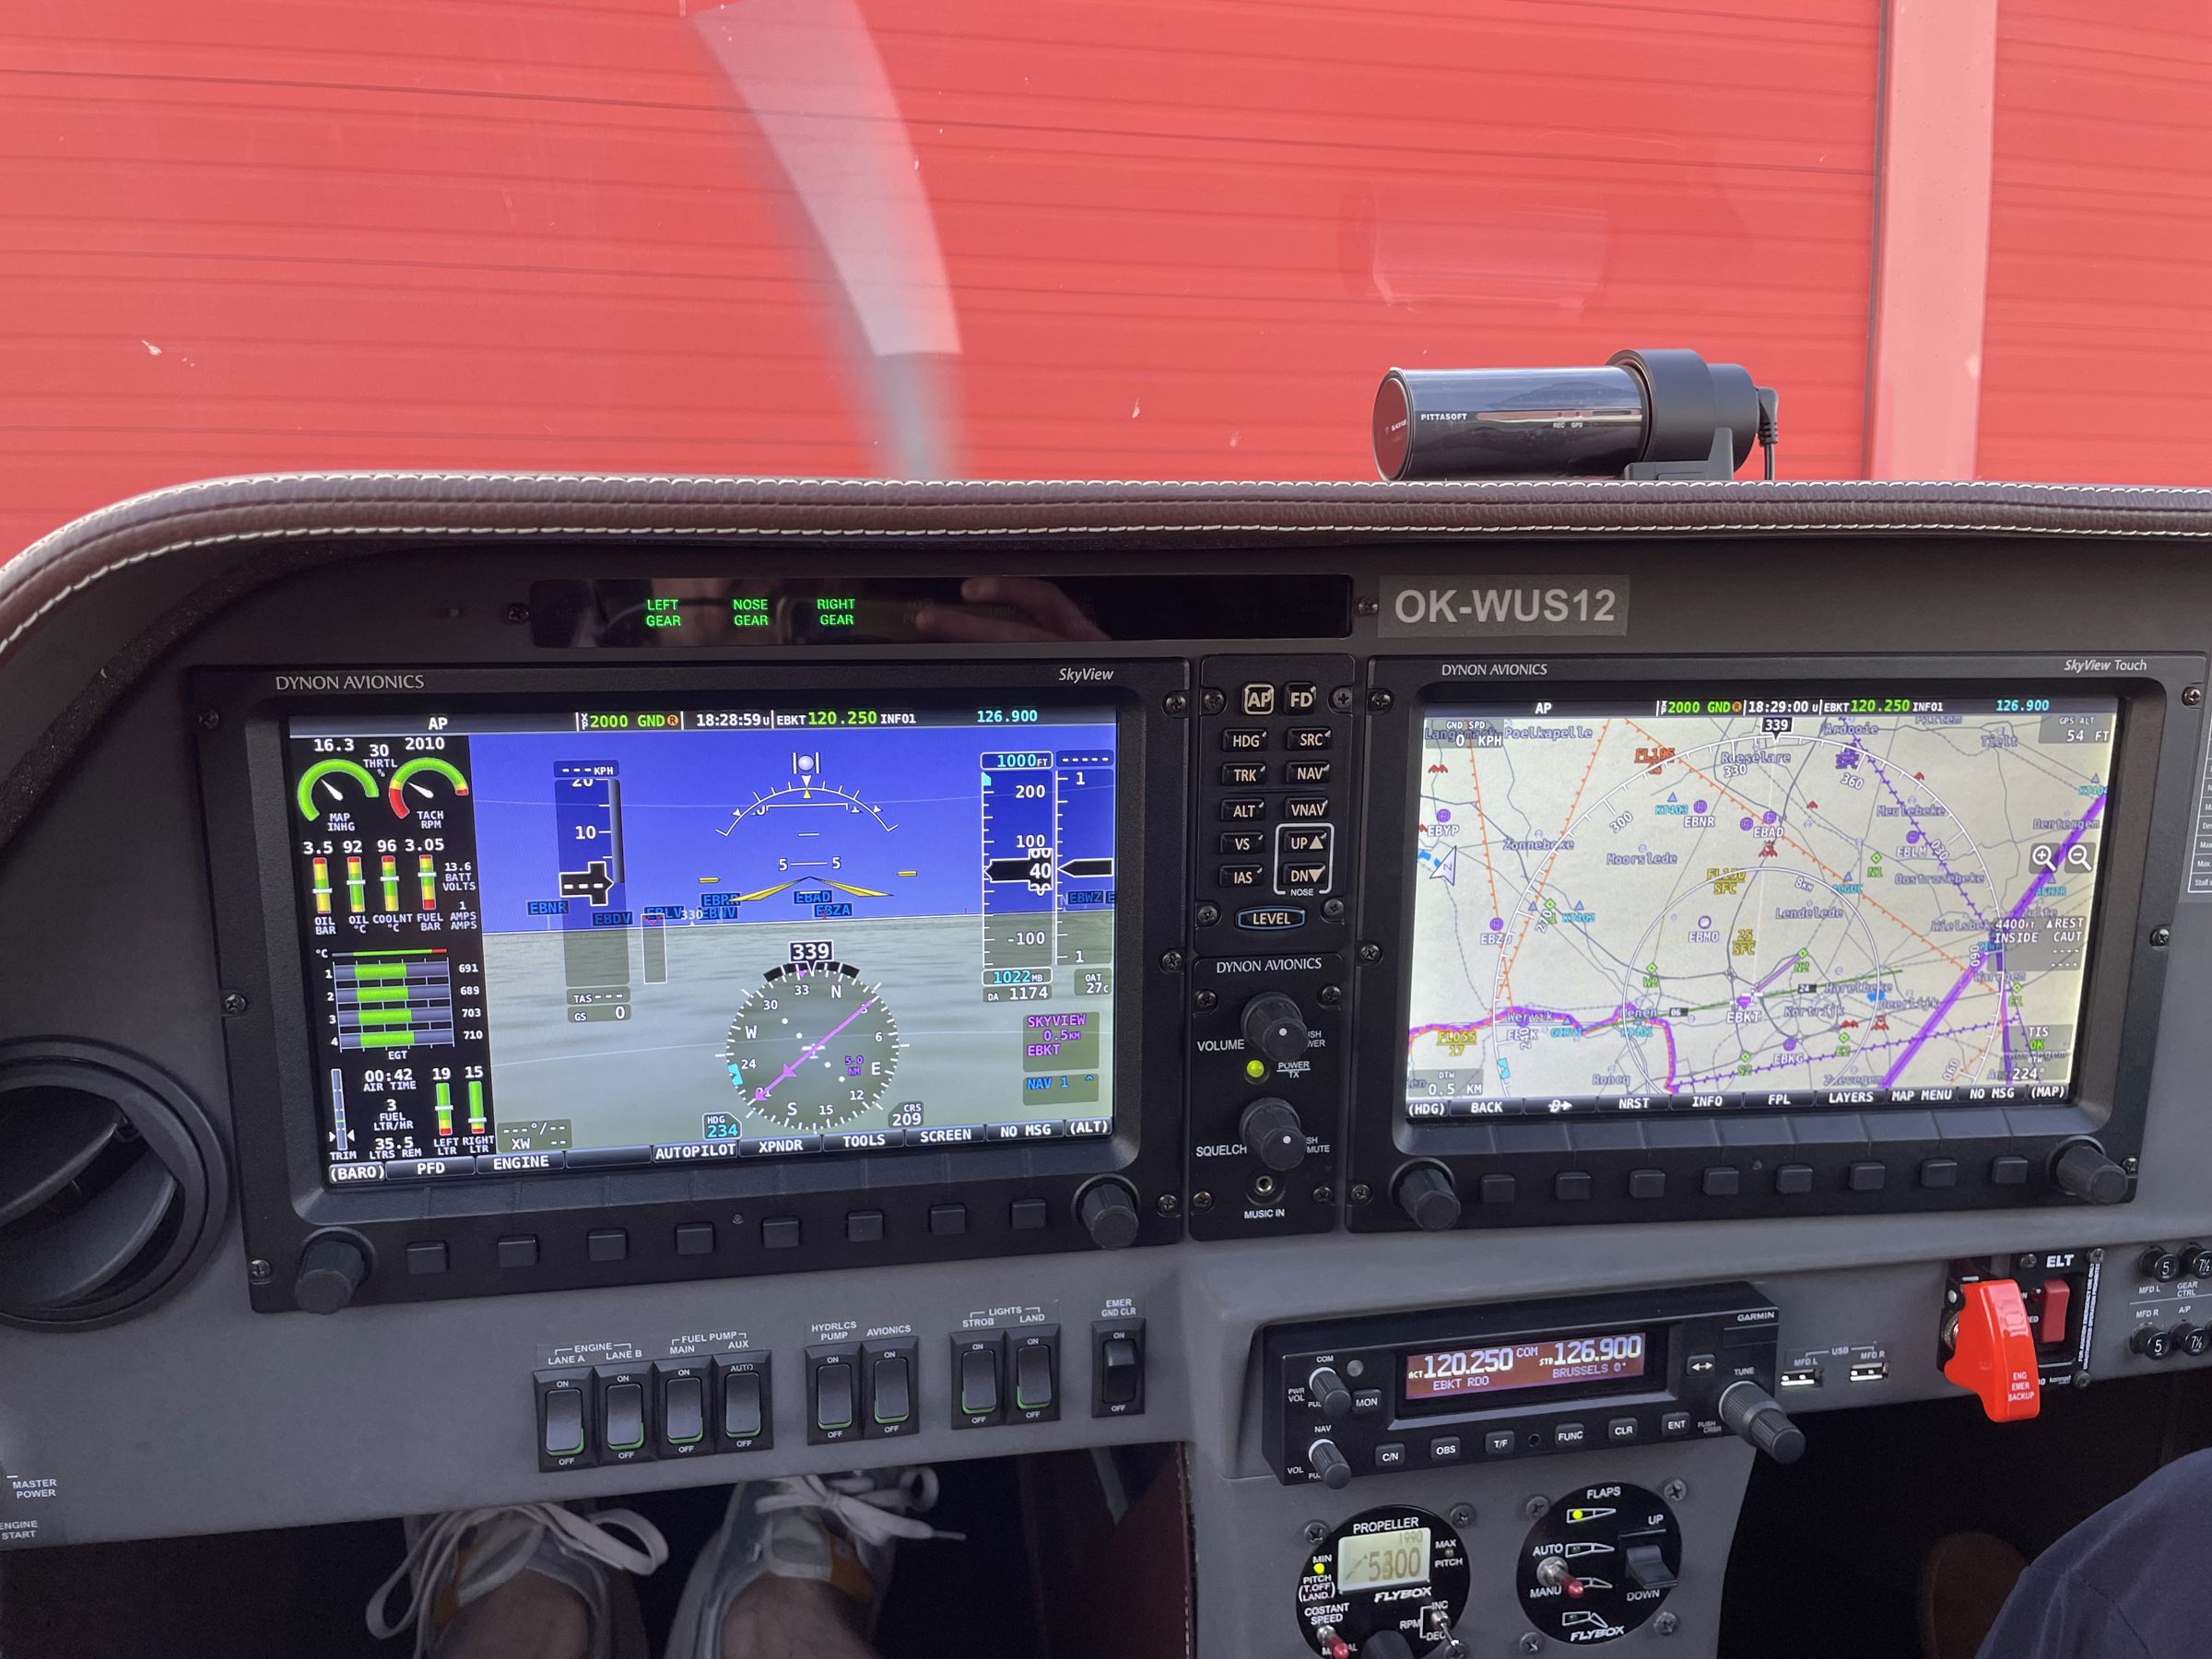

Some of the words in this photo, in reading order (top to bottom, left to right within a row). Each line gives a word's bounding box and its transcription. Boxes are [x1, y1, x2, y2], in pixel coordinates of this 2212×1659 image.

[1420, 413, 1467, 421] PITTASOFT
[647, 599, 678, 611] LEFT
[733, 599, 768, 611] NOSE
[817, 598, 855, 610] RIGHT
[1394, 588, 1615, 624] OK-WUS12
[646, 615, 681, 628] GEAR
[734, 615, 768, 627] GEAR
[820, 614, 853, 626] GEAR
[1441, 664, 1488, 677] DYNON
[1489, 664, 1547, 676] AVIONICS
[2065, 659, 2111, 674] SkyView
[2114, 659, 2147, 672] Touch
[1059, 668, 1113, 684] SkyView
[276, 676, 339, 690] DYNON
[343, 675, 425, 689] AVIONICS
[1248, 692, 1271, 707] AP
[1290, 692, 1313, 707] FD
[1535, 702, 1552, 714] AP
[1824, 702, 1849, 712] EBKT
[1850, 700, 1911, 712] 120.250
[1912, 701, 1944, 712] INFO1
[1996, 700, 2050, 712] 126.900
[777, 714, 806, 725] EBKT
[808, 711, 877, 725] 120.250
[880, 713, 916, 724] INFO1
[977, 710, 1038, 724] 126.900
[429, 717, 448, 731] AP
[1446, 721, 1463, 729] GND
[1468, 721, 1485, 729] SPD
[1765, 719, 1788, 731] 339
[1233, 735, 1260, 747] HDG
[1300, 734, 1323, 746] SRC
[2066, 730, 2084, 742] 54
[2095, 731, 2109, 742] FT
[314, 739, 355, 751] 16.3
[406, 737, 444, 750] 2010
[370, 744, 389, 757] 30
[363, 759, 398, 769] THRTL
[594, 767, 614, 775] KPH
[1234, 770, 1256, 782] TRK
[1297, 768, 1323, 780] NAV
[1016, 785, 1045, 798] 200
[1233, 805, 1255, 818] ALT
[1291, 804, 1325, 817] VNAV
[1684, 816, 1715, 828] EBNR
[1428, 825, 1459, 837] EBYP
[1753, 827, 1784, 838] EBAD
[303, 841, 333, 854] 3.5
[343, 841, 362, 853] 92
[377, 840, 396, 853] 96
[405, 839, 444, 852] 3.05
[1016, 835, 1045, 848] 100
[1235, 839, 1251, 850] VS
[1291, 838, 1308, 849] UP
[445, 873, 472, 882] BATT
[1234, 871, 1253, 884] IAS
[1291, 870, 1309, 882] DN
[372, 913, 413, 924] COOLNT
[1253, 912, 1291, 925] LEVEL
[2054, 917, 2085, 928] REST
[1688, 932, 1719, 943] EBMO
[1994, 932, 2039, 943] INSIDE
[2053, 931, 2083, 942] CAUT
[792, 944, 830, 960] 339
[459, 963, 478, 973] 691
[1217, 959, 1261, 973] DYNON
[1265, 958, 1322, 971] AVIONICS
[462, 1008, 481, 1018] 703
[1726, 1011, 1761, 1024] EBKT
[1027, 1014, 1087, 1027] SKYVIEW
[2029, 1027, 2049, 1037] TIS
[1027, 1044, 1060, 1056] EBKT
[1197, 1040, 1244, 1052] VOLUME
[1829, 1092, 1874, 1104] LAYERS
[1891, 1090, 1915, 1101] MAP
[1921, 1088, 1952, 1100] MENU
[1970, 1088, 1985, 1100] NO
[1991, 1088, 2015, 1099] MSG
[2030, 1086, 2065, 1099] (MAP)
[1618, 1099, 1650, 1109] NRST
[1692, 1097, 1723, 1107] INFO
[1768, 1094, 1791, 1105] FPL
[1408, 1103, 1445, 1116] (HDG)
[1471, 1102, 1503, 1113] BACK
[892, 1113, 922, 1126] 209
[707, 1124, 737, 1137] 234
[1000, 1125, 1018, 1137] NO
[1025, 1124, 1052, 1136] MSG
[1069, 1121, 1108, 1135] (ALT)
[842, 1134, 886, 1147] TOOLS
[920, 1129, 972, 1143] SCREEN
[375, 1137, 414, 1150] 35.5
[758, 1138, 804, 1153] XPNDR
[655, 1142, 736, 1160] AUTOPILOT
[417, 1162, 445, 1175] PFD
[494, 1155, 549, 1170] ENGINE
[2046, 1254, 2074, 1268] ELT
[1106, 1299, 1132, 1308] EMER
[988, 1306, 1022, 1316] LIGHTS
[1101, 1308, 1119, 1317] GND
[1120, 1307, 1136, 1316] CLR
[1736, 1311, 1775, 1322] GARMIN
[962, 1318, 995, 1327] STROB
[1019, 1313, 1045, 1324] LAND
[811, 1321, 857, 1333] HYDRLCS
[865, 1324, 912, 1337] AVIONICS
[681, 1334, 707, 1344] FUEL
[709, 1332, 737, 1341] PUMP
[820, 1330, 849, 1341] PUMP
[574, 1343, 613, 1353] ENGINE
[669, 1345, 695, 1355] MAIN
[728, 1340, 749, 1349] AUX
[1408, 1370, 1423, 1380] ACT
[1423, 1347, 1513, 1379] 120.250
[1516, 1347, 1538, 1358] COM
[1539, 1357, 1554, 1366] STB
[1554, 1335, 1642, 1366] 126.900
[1831, 1347, 1849, 1356] USB
[1316, 1355, 1334, 1363] COM
[730, 1364, 754, 1372] AUTO
[1552, 1363, 1608, 1379] BRUSSELS
[1433, 1379, 1462, 1391] EBKT
[1467, 1376, 1489, 1387] RDO
[1355, 1397, 1378, 1407] MON
[2007, 1392, 2035, 1402] BACKUP
[1314, 1425, 1332, 1433] NAV
[1615, 1425, 1633, 1436] CLR
[1667, 1419, 1687, 1430] ENT
[1558, 1430, 1583, 1441] FUNC
[1436, 1445, 1456, 1455] OBS
[1382, 1452, 1399, 1462] C/N
[13, 1478, 57, 1489] MASTER
[16, 1488, 56, 1500] POWER
[1586, 1487, 1621, 1500] FLAPS
[1648, 1514, 1665, 1525] UP
[1353, 1517, 1419, 1535] PROPELLER
[1, 1530, 37, 1540] START
[1435, 1539, 1457, 1548] MAX
[1532, 1543, 1564, 1557] AUTO
[1312, 1554, 1332, 1563] MIN
[1434, 1558, 1463, 1568] PITCH
[1303, 1574, 1332, 1584] PITCH
[1374, 1586, 1432, 1603] FLYBOX
[1530, 1585, 1562, 1598] MANU
[1627, 1590, 1660, 1602] DOWN
[1304, 1603, 1350, 1617] COSTANT
[1311, 1614, 1343, 1625] SPEED
[1570, 1626, 1625, 1641] FLYBOX
